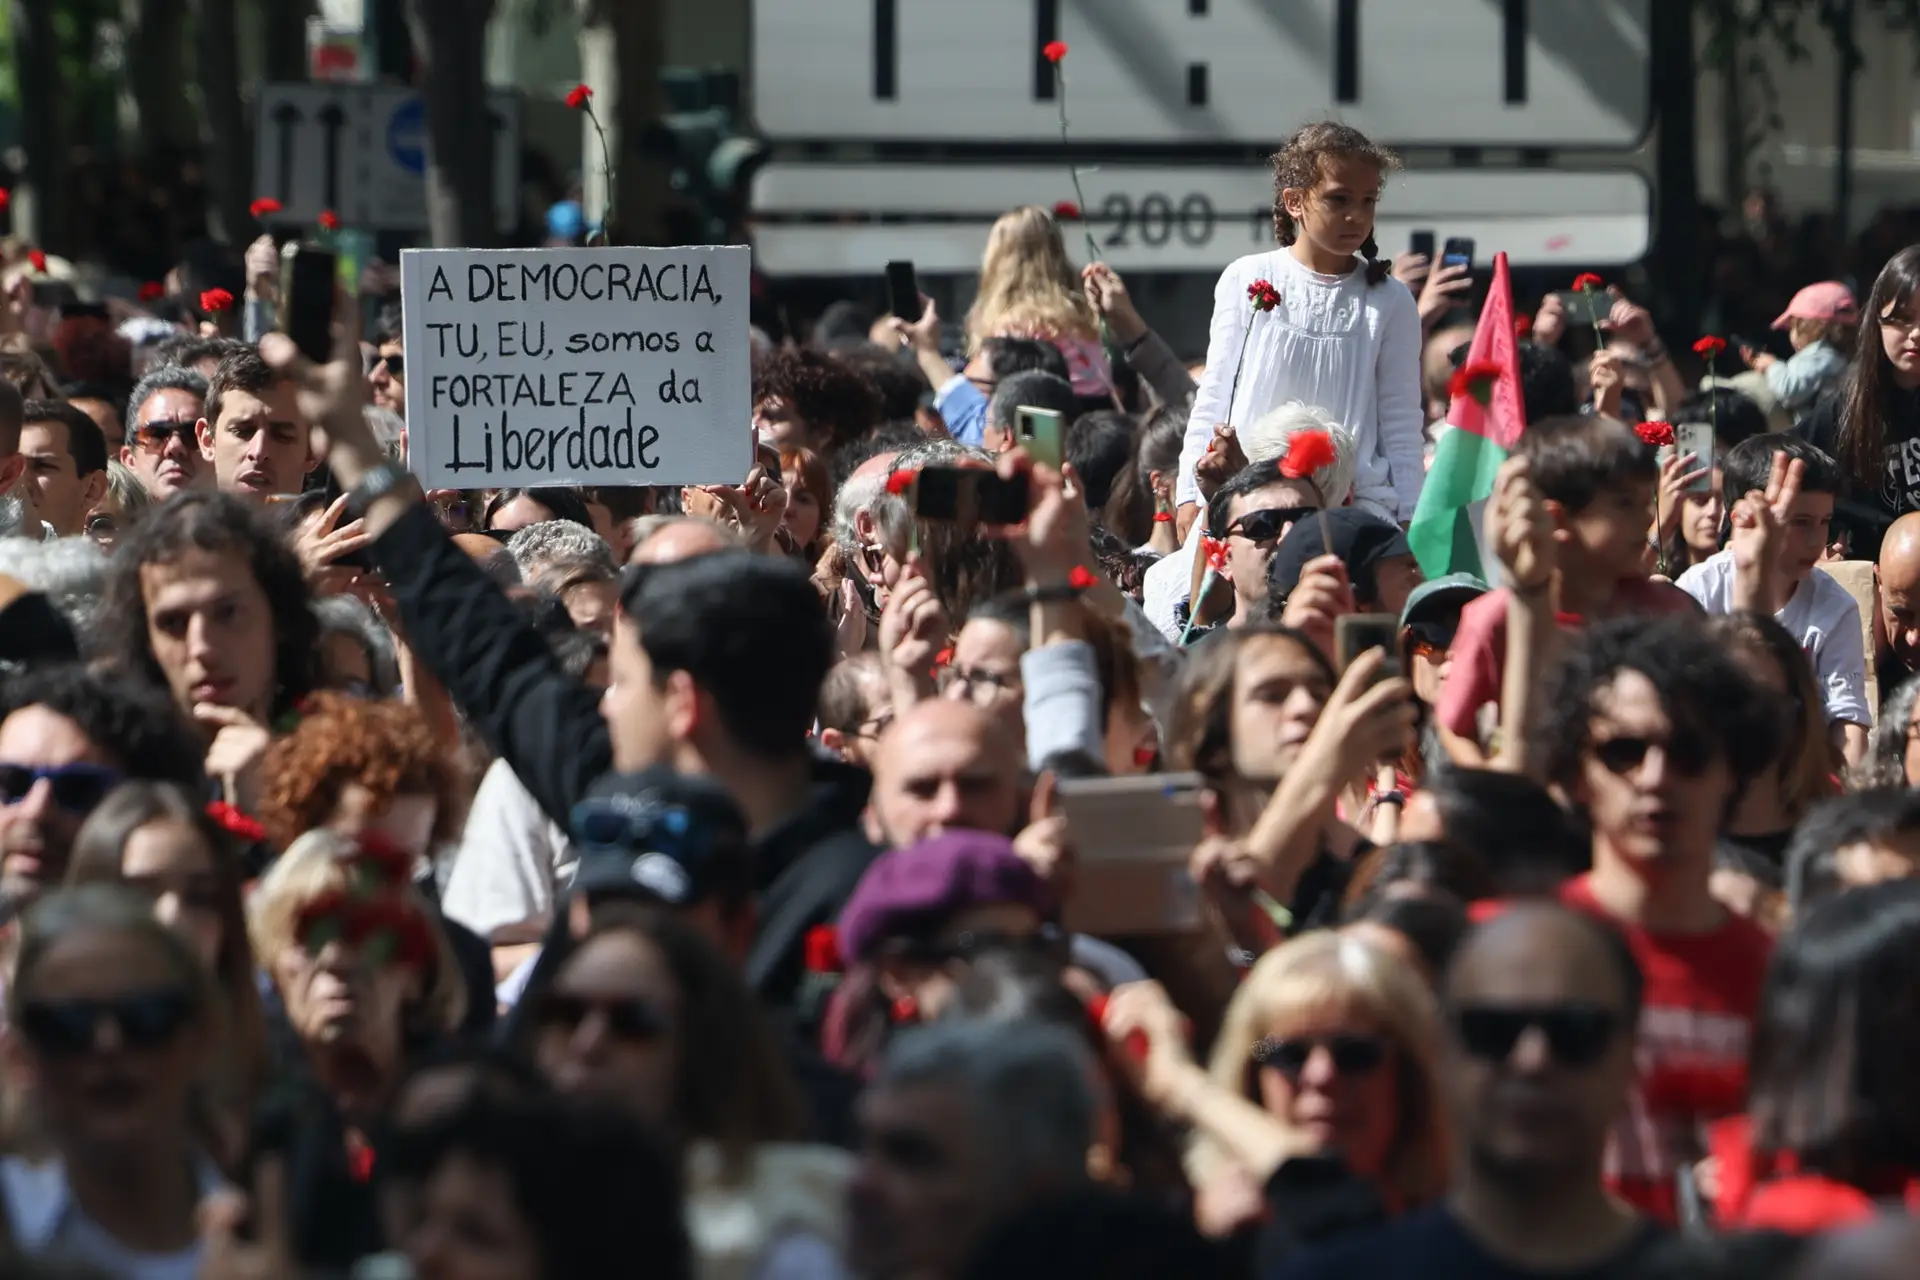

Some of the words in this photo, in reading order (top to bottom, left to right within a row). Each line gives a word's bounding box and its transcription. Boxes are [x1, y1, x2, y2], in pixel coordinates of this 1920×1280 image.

[1102, 191, 1215, 247] 200
[427, 265, 454, 303] A
[468, 263, 723, 305] DEMOCRACIA,
[426, 322, 488, 363] TU,
[497, 320, 554, 360] EU,
[564, 330, 680, 354] somos
[695, 332, 715, 353] a
[432, 371, 636, 408] FORTALEZA
[658, 368, 703, 404] da
[444, 406, 660, 473] Liberdade
